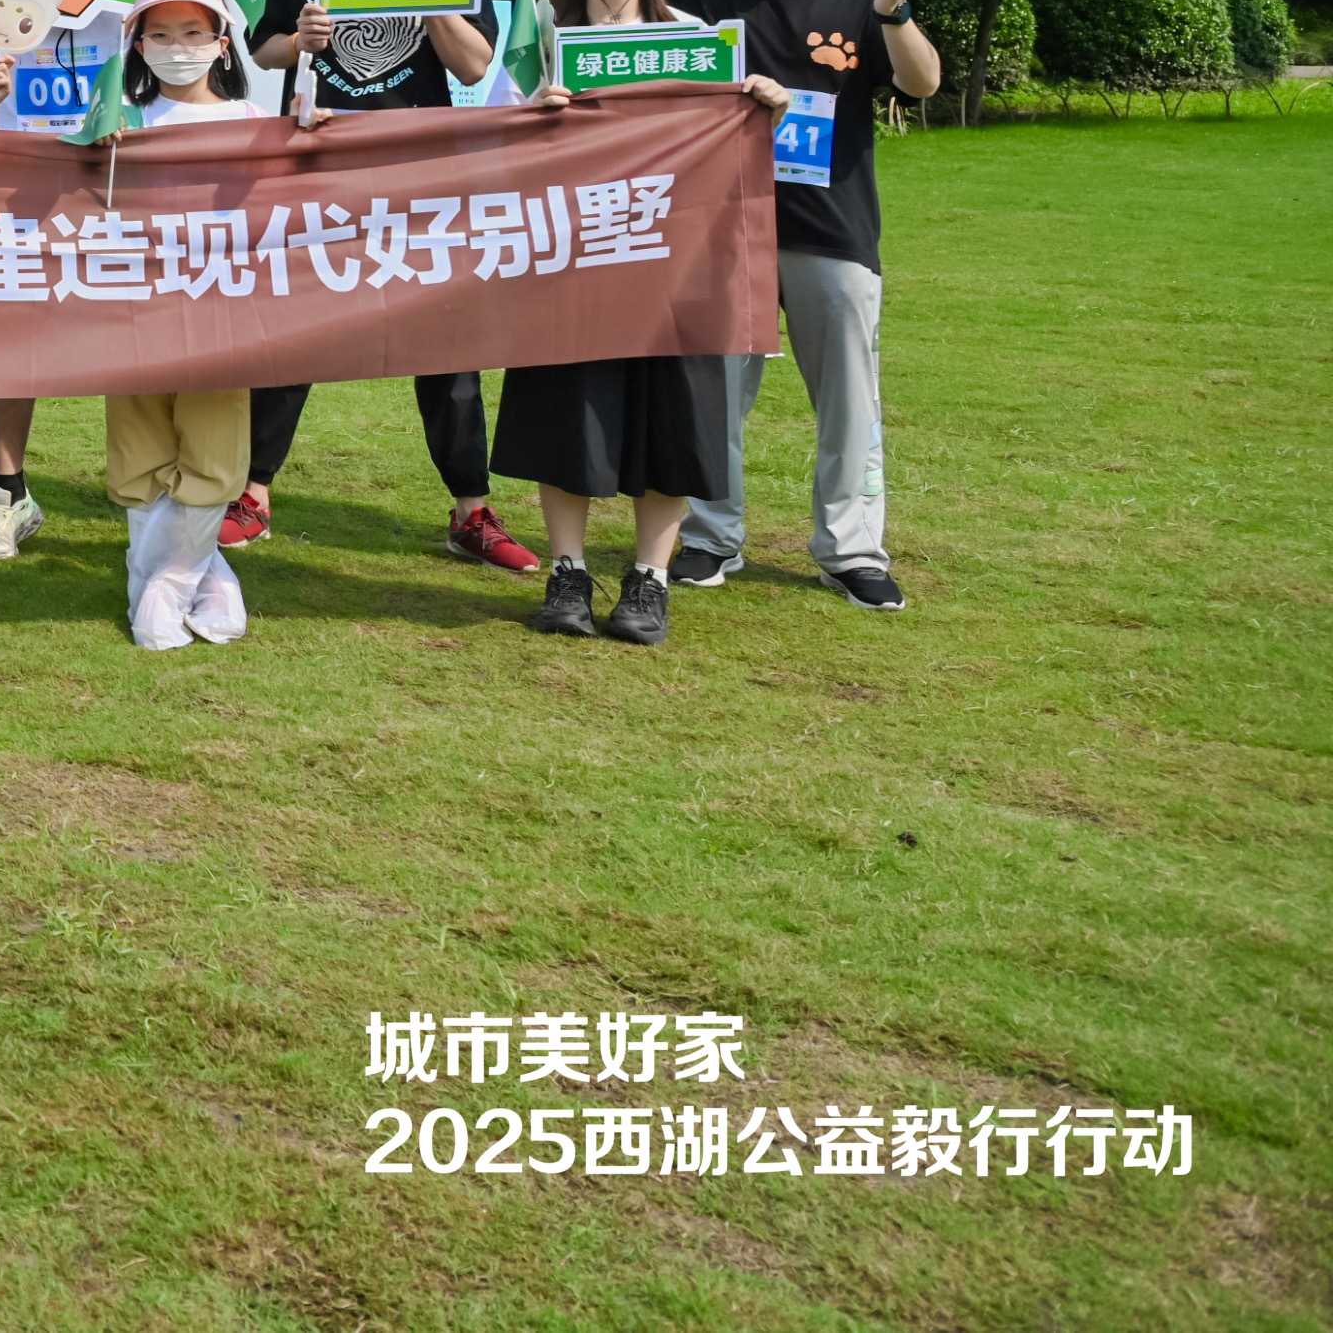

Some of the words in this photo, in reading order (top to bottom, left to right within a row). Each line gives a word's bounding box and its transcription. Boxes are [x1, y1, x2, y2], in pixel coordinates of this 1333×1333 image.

[576, 47, 718, 78] 绿色健康家
[29, 76, 90, 107] 001
[326, 73, 385, 98] BEFORE
[386, 67, 415, 89] SEEN
[776, 122, 820, 156] 41
